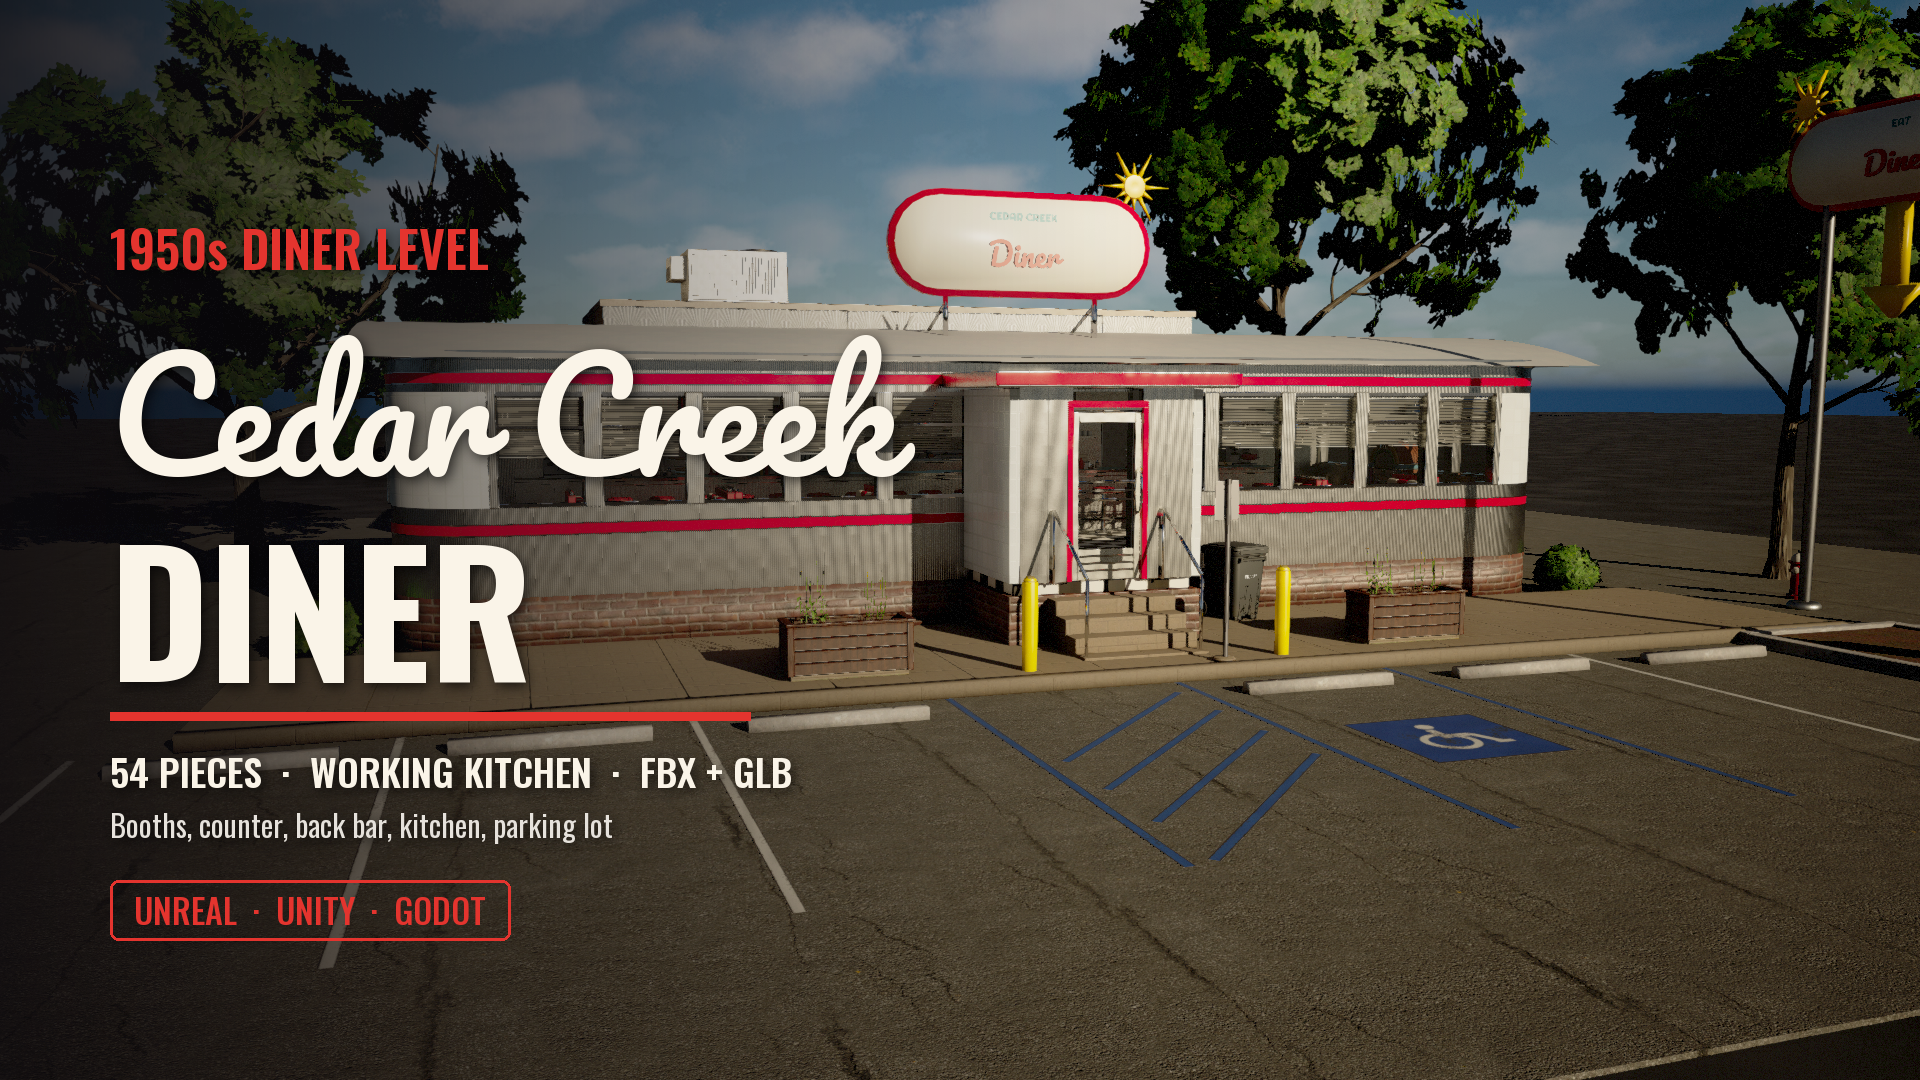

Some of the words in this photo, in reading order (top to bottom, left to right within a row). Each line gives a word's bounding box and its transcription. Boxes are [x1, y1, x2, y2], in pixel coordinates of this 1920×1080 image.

[1892, 116, 1911, 127] EAT
[1864, 149, 1920, 177] Dine
[990, 212, 1023, 222] CEDAR
[1026, 213, 1057, 222] CREEK
[989, 239, 1064, 268] Diner
